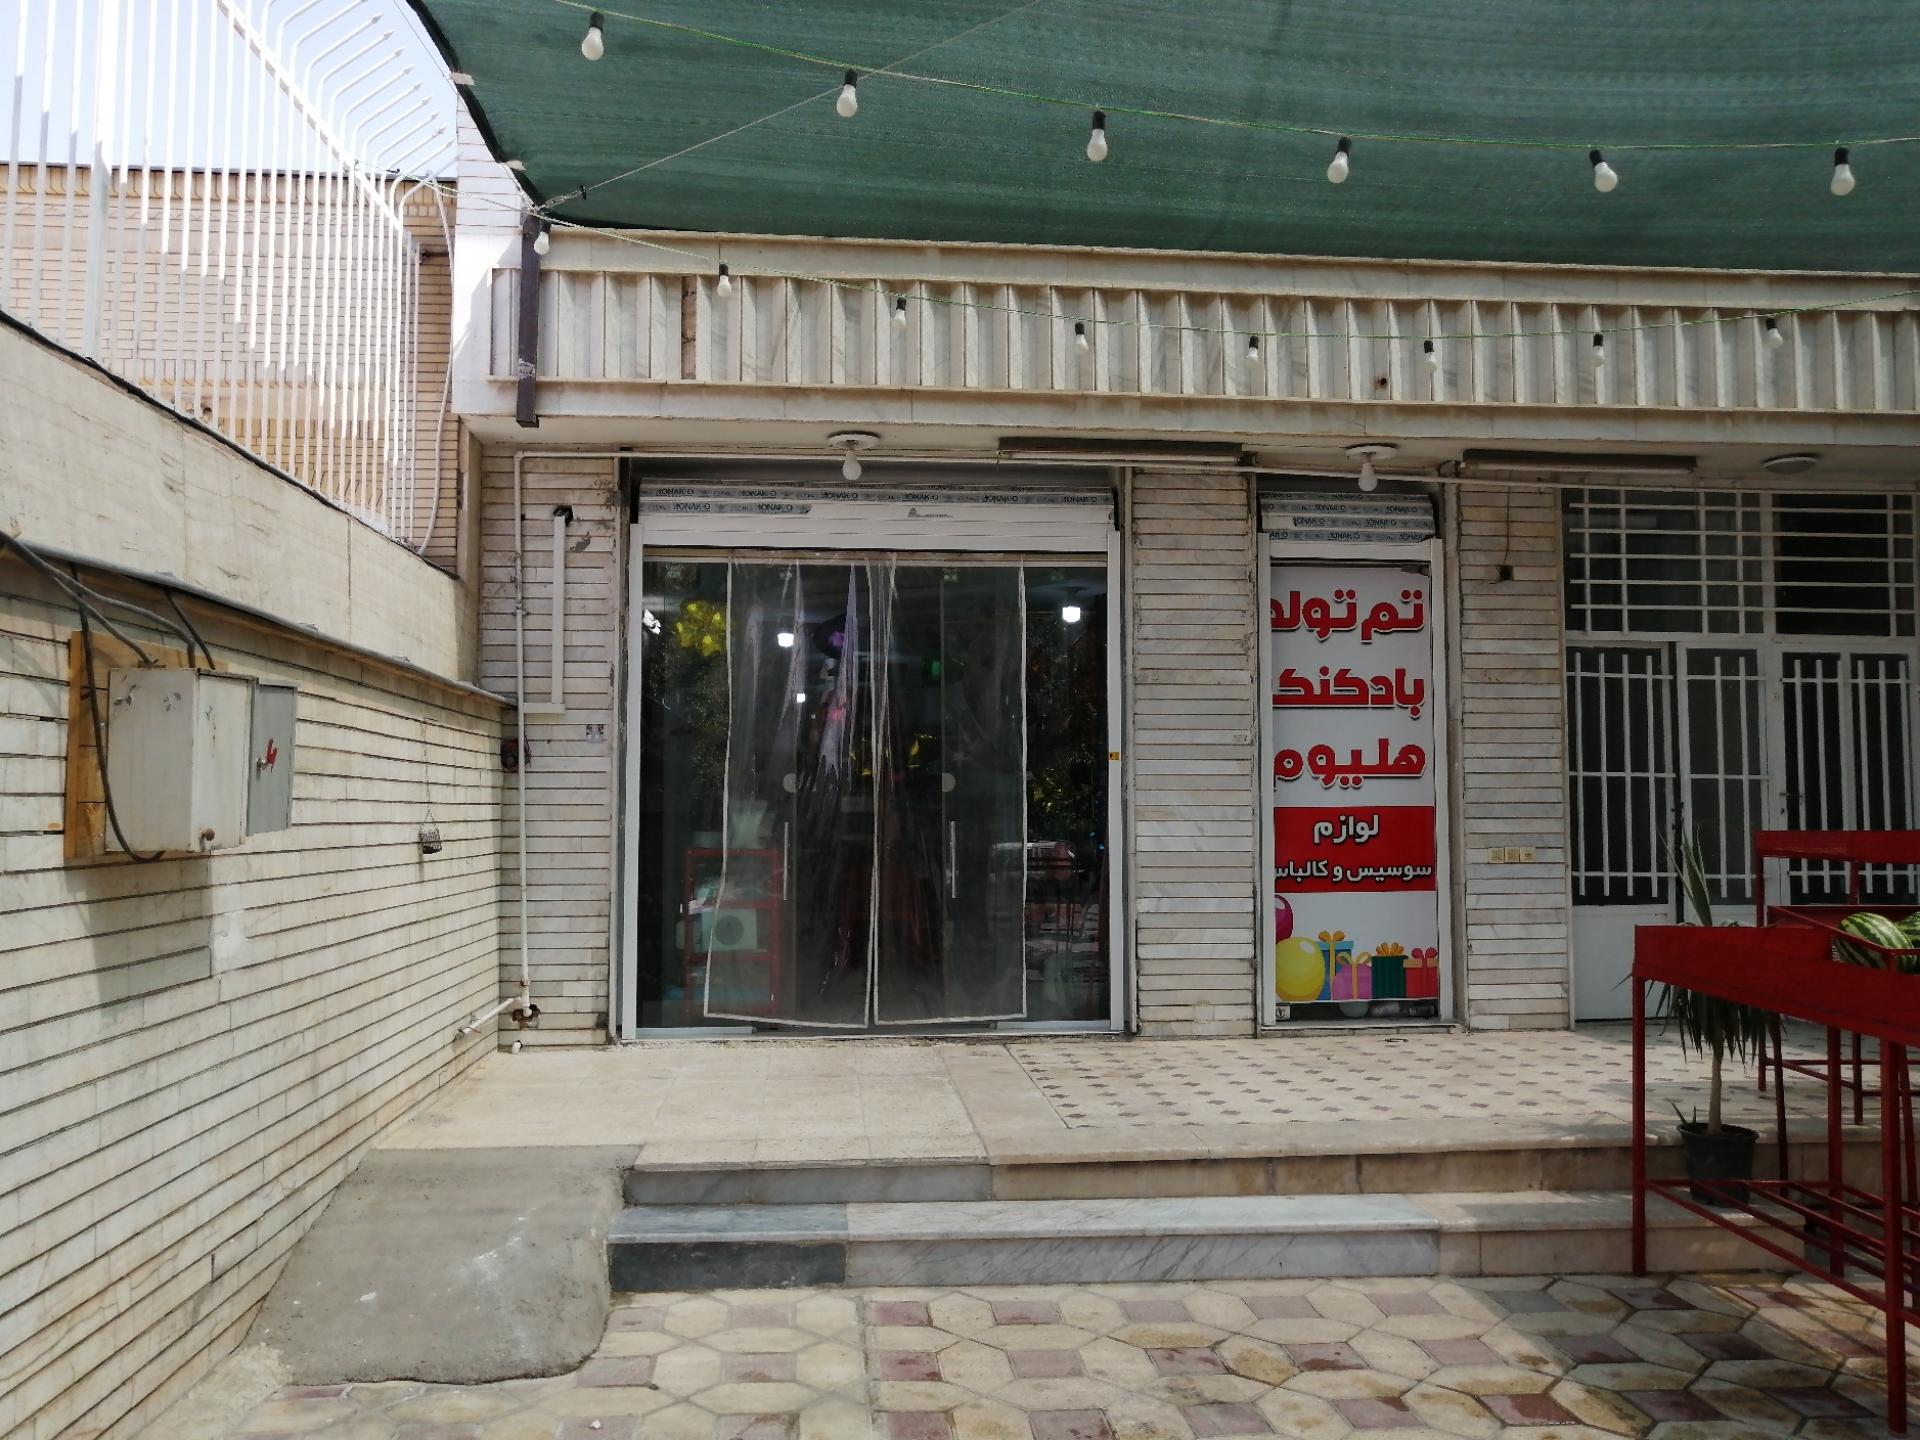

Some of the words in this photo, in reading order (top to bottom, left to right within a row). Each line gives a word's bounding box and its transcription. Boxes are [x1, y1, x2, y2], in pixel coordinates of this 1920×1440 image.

[1360, 588, 1424, 642] تم
[1273, 737, 1426, 787] هلیوم
[1312, 813, 1380, 844] لوازم
[1332, 864, 1343, 882] و
[1346, 863, 1432, 883] سوسیس
